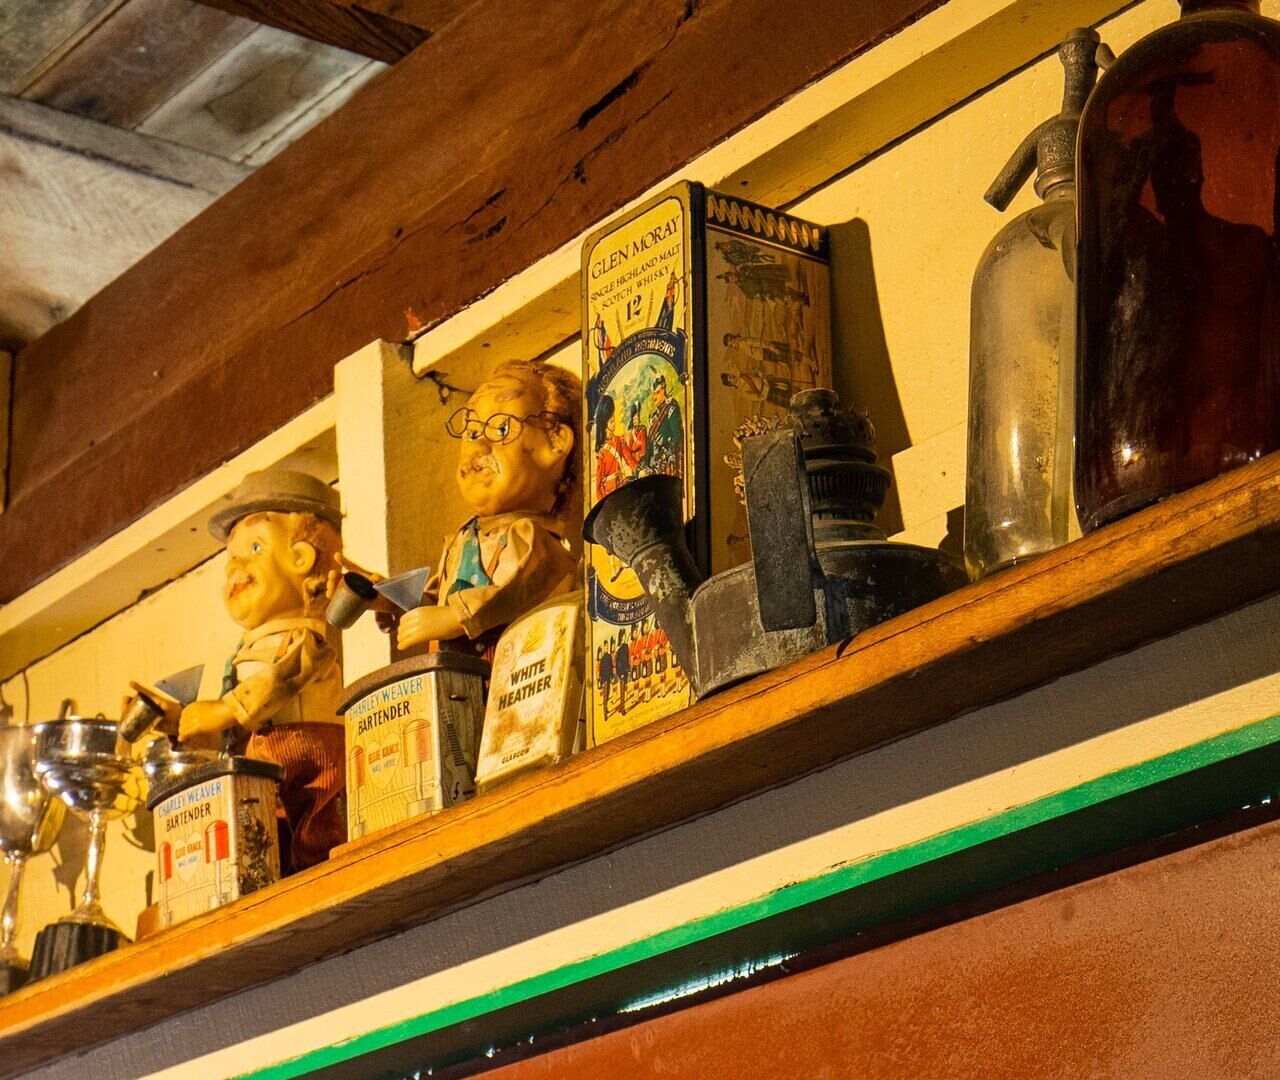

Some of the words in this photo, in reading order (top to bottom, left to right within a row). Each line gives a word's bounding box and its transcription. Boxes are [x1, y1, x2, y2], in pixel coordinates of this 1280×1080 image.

[591, 245, 632, 280] GLEN
[632, 215, 681, 258] MORAY
[590, 282, 615, 304] SINGLE
[616, 259, 658, 290] HIGHLAND
[658, 243, 681, 266] MALT
[601, 285, 634, 312] SCOTCH
[636, 264, 671, 289] WHISKY
[625, 293, 643, 323] 12
[509, 658, 546, 687] WHITE
[348, 695, 381, 722] CHARLEY
[381, 677, 424, 703] WEAVER
[497, 674, 552, 712] HEATHER
[357, 700, 411, 736] BARTENDER
[383, 757, 397, 770] HERE
[501, 746, 531, 765] GLASGOW
[158, 795, 187, 819] CHARLEY
[188, 781, 222, 804] WEAVER
[166, 802, 211, 832] BARTENDER
